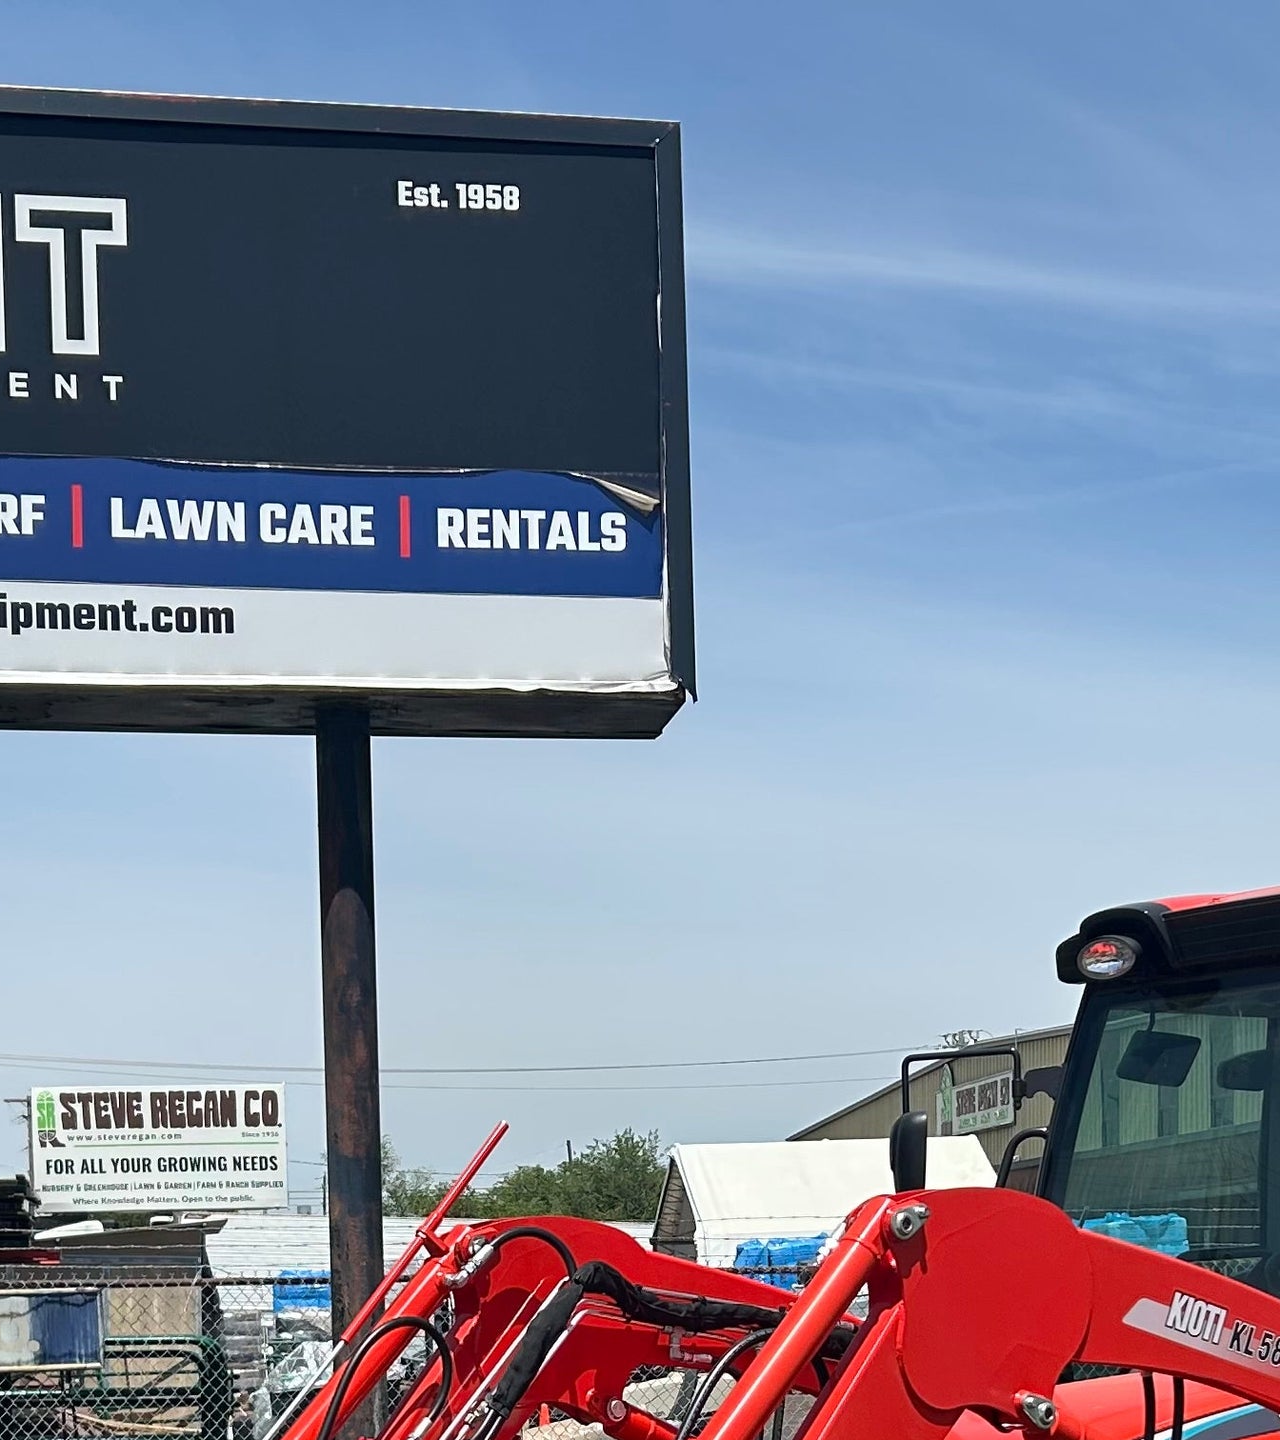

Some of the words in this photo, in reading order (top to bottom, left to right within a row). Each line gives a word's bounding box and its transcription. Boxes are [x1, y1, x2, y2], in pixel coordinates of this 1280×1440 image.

[397, 179, 448, 208] Est.
[454, 181, 520, 211] 1958
[111, 497, 246, 542] LAWN
[259, 502, 375, 547] CARE
[436, 507, 627, 552] RENTALS
[59, 1091, 145, 1130] STEVE
[150, 1090, 237, 1129] REGAN
[244, 1090, 283, 1128] CO.
[67, 1132, 182, 1142] www.steveregan.com
[46, 1159, 75, 1175] FOR
[80, 1158, 107, 1174] ALL
[110, 1157, 152, 1174] YOUR
[157, 1156, 228, 1173] GROWING
[233, 1155, 278, 1171] NEEDS
[1166, 1290, 1228, 1345] KIOTI
